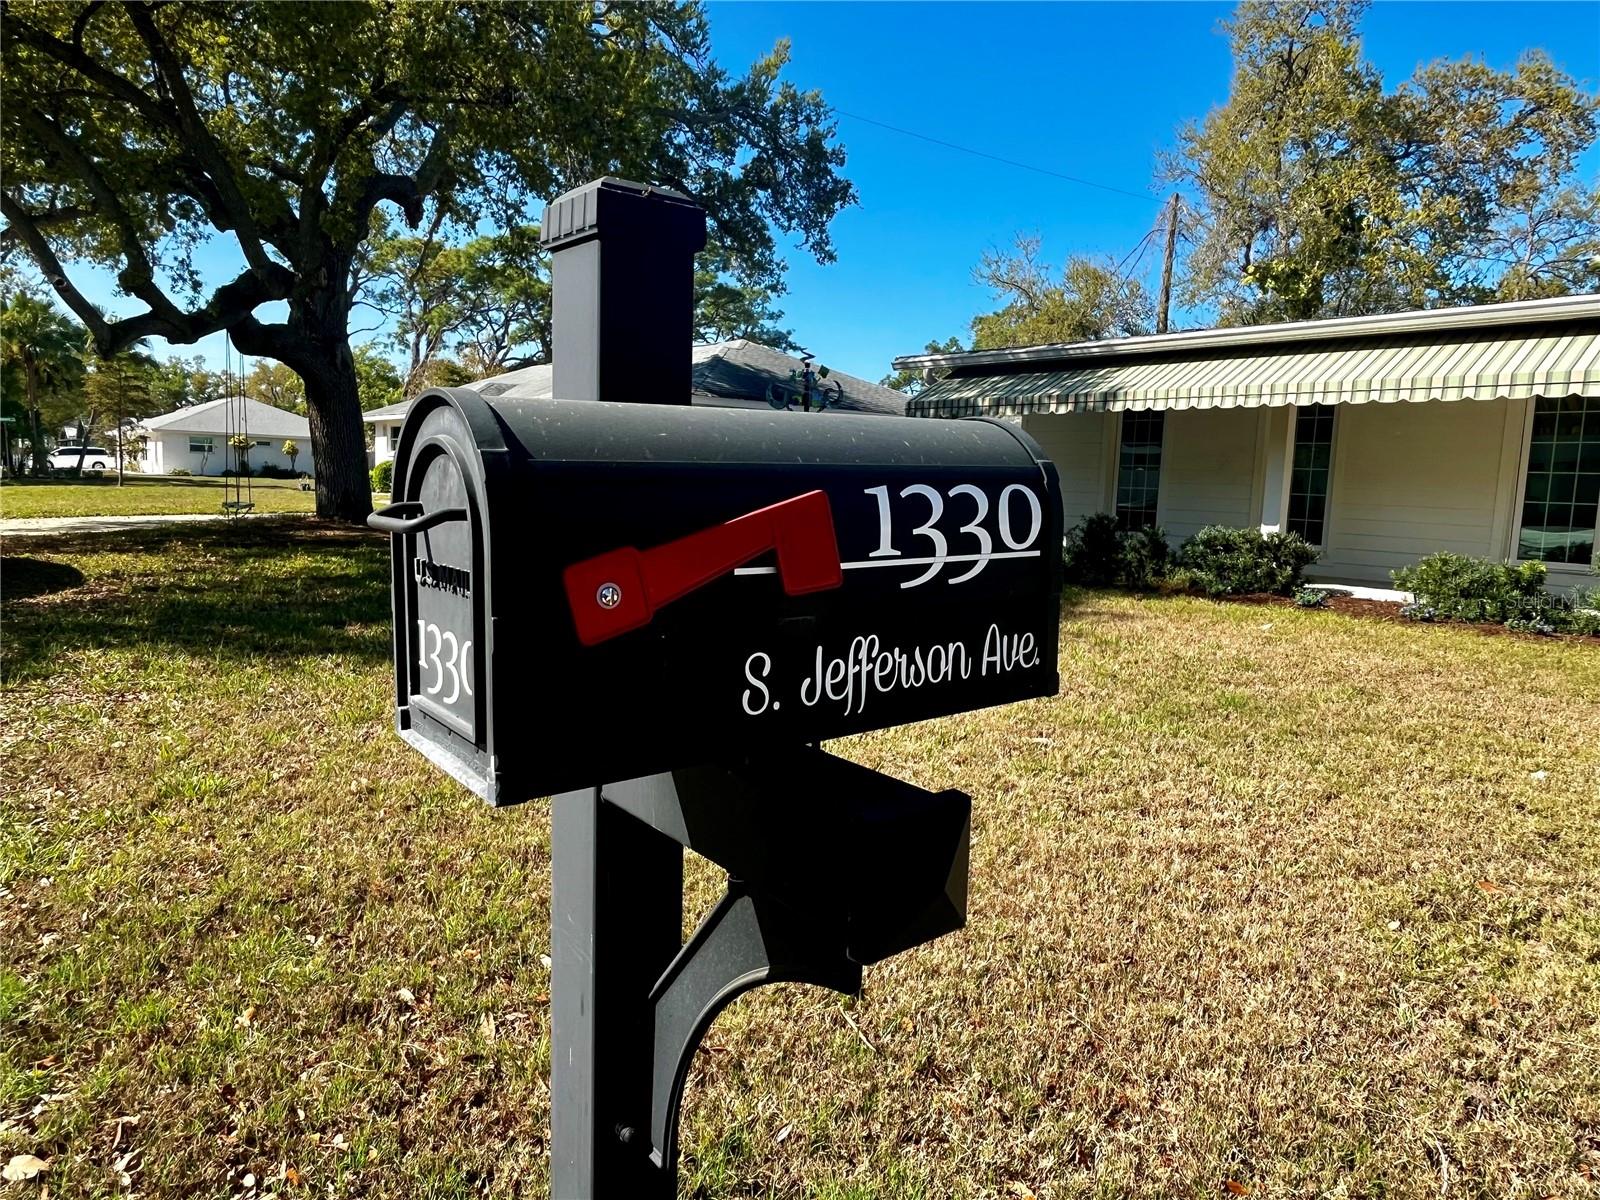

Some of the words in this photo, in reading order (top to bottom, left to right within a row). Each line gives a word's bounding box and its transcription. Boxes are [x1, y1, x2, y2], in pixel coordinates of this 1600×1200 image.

[863, 483, 1043, 589] 1330
[741, 652, 781, 716] S.
[800, 634, 972, 717] Jefferson
[981, 623, 1041, 677] Ave.
